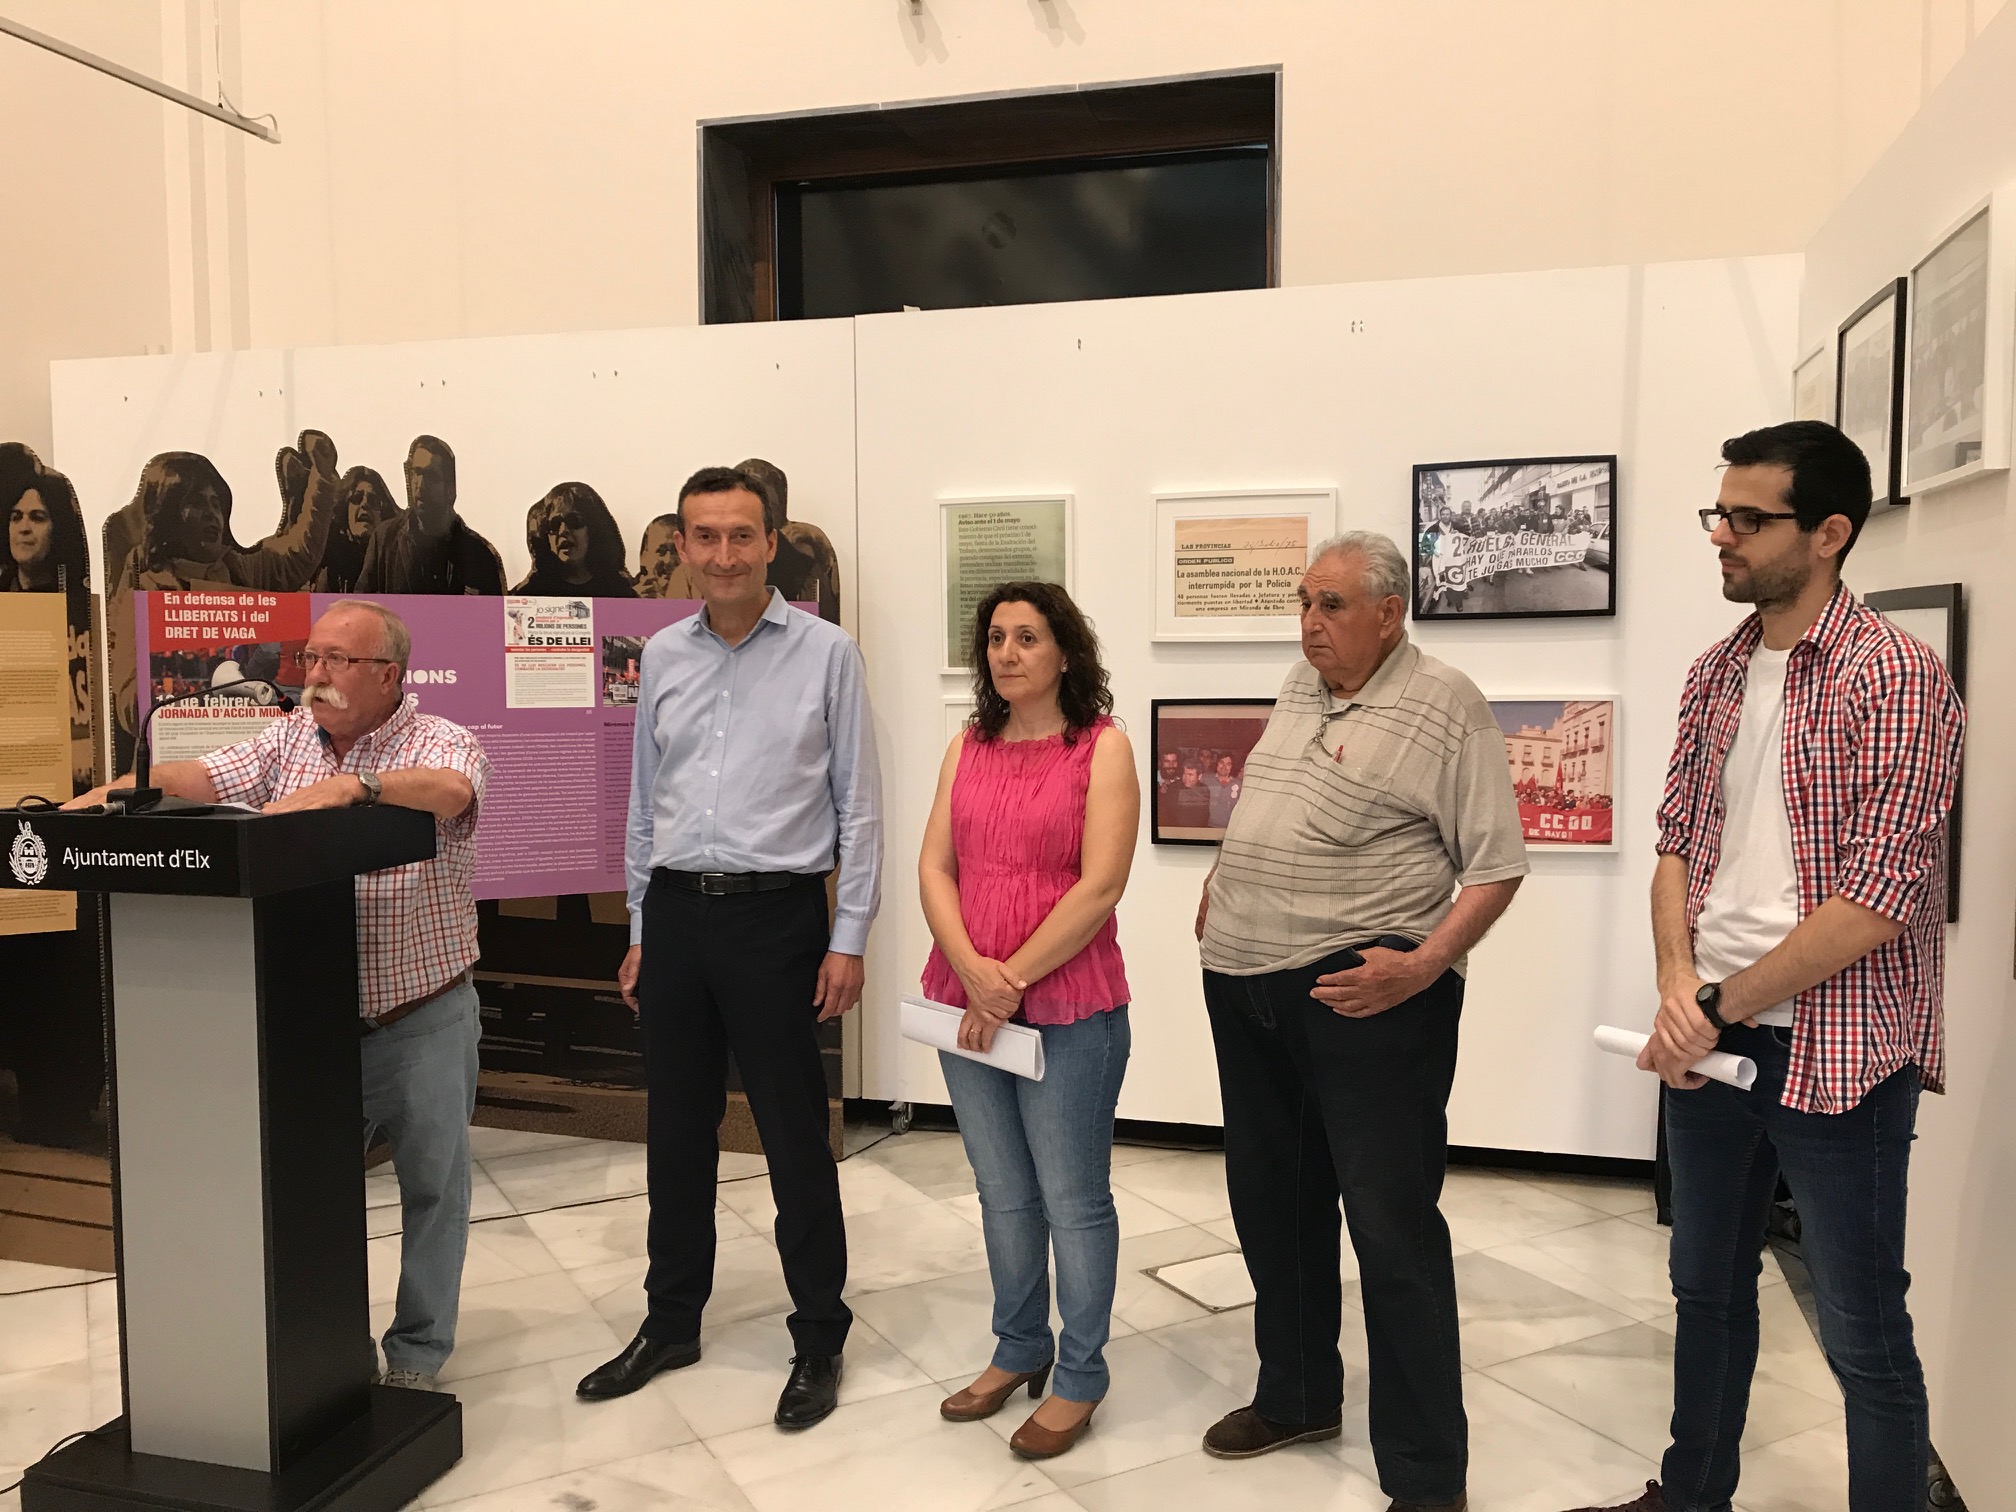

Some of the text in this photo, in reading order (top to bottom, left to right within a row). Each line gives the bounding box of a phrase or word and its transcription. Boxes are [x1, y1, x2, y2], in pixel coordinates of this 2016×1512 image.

[1520, 532, 1576, 547] GENERAL
[1466, 554, 1484, 567] HAY
[1177, 570, 1185, 578] La
[1186, 569, 1220, 578] asamblea
[1221, 568, 1251, 577] nacional
[1253, 568, 1262, 576] de
[1264, 568, 1270, 576] la
[1468, 570, 1478, 579] TE
[1516, 558, 1548, 567] MUCHO
[1188, 581, 1235, 590] interrumpida
[164, 592, 277, 606] En defensa de les
[164, 609, 269, 623] LLIBERTATS i del
[528, 616, 535, 629] 2
[165, 626, 256, 639] DRET DE VAGA
[528, 634, 591, 646] ÉS DE LLEI
[402, 670, 457, 684] IONS
[204, 694, 250, 707] febrer
[406, 692, 419, 707] S
[158, 708, 209, 719] JORNADA
[1529, 828, 1540, 836] DE
[62, 847, 210, 870] Ajuntament d'Elx
